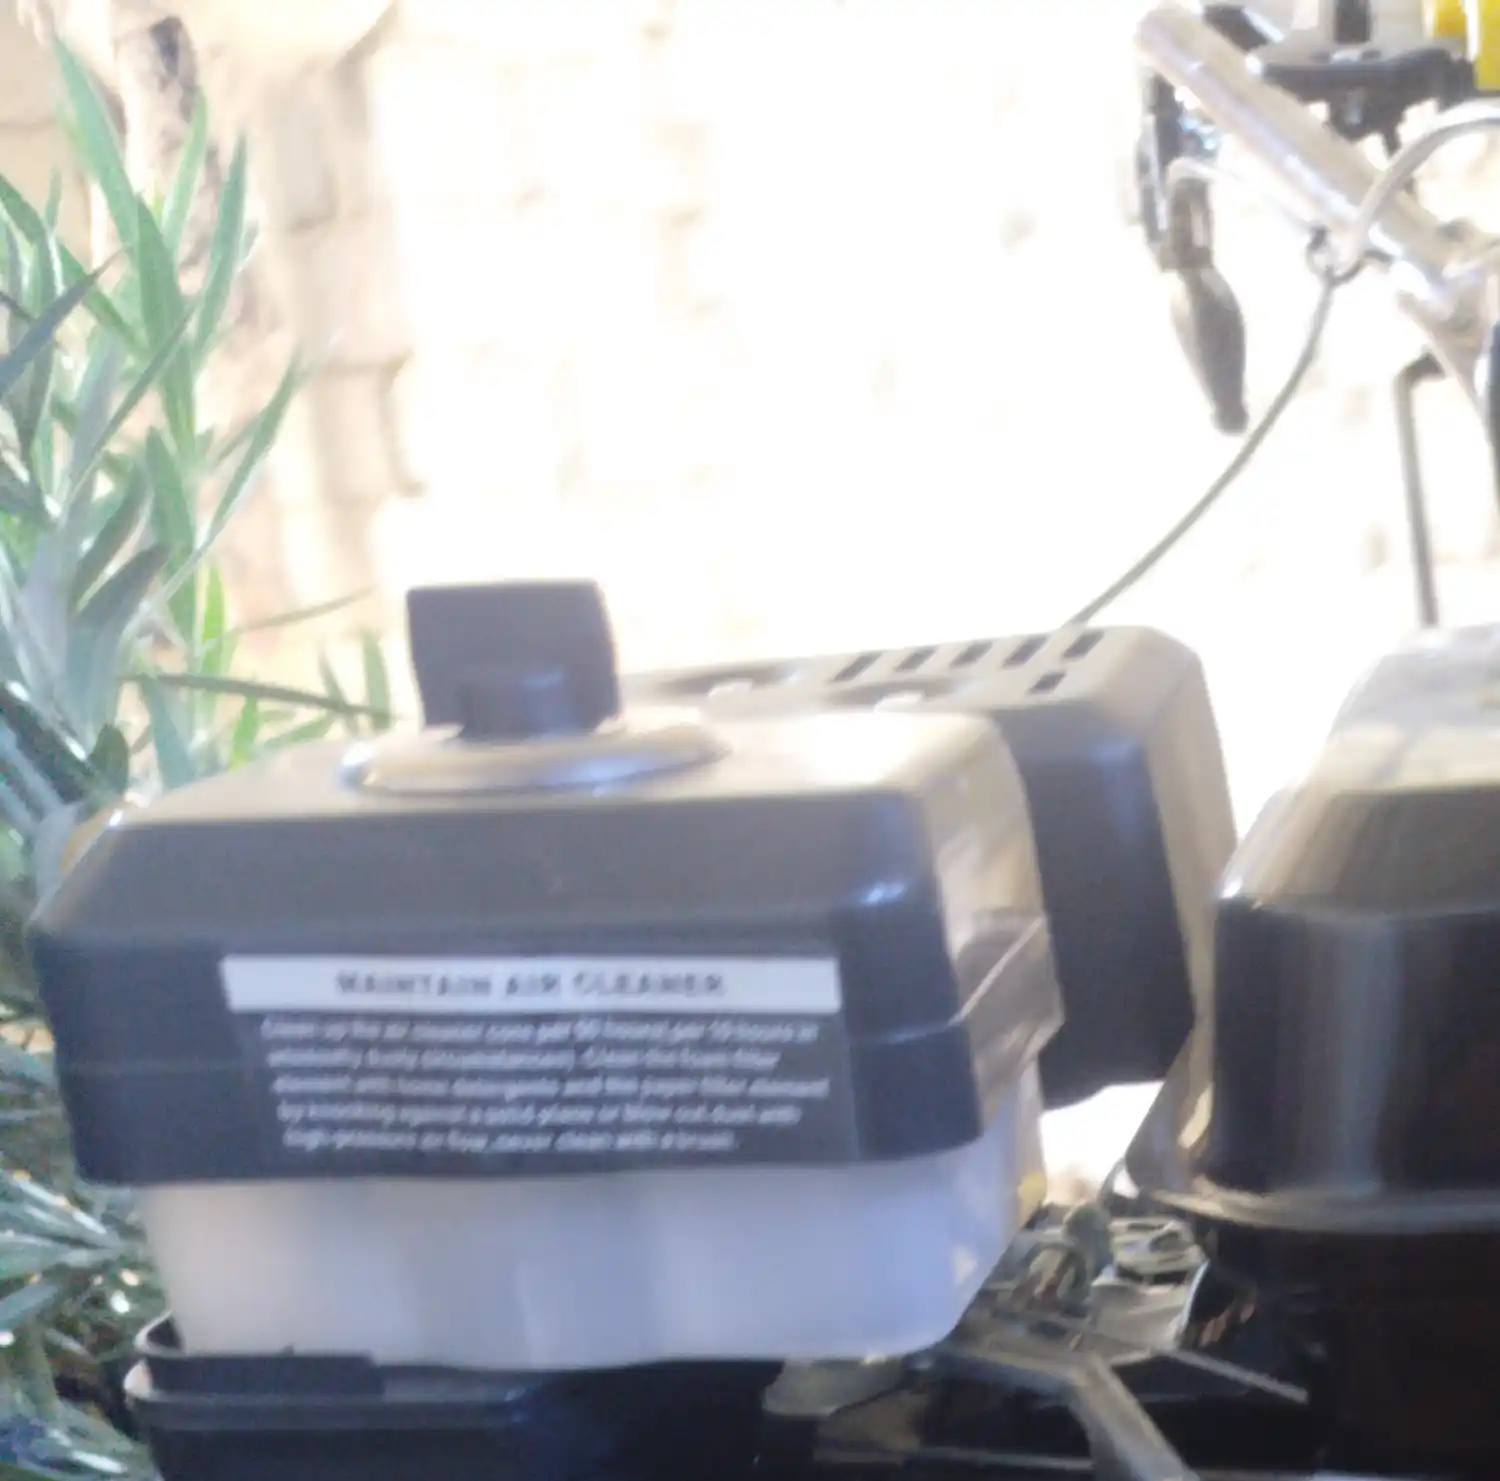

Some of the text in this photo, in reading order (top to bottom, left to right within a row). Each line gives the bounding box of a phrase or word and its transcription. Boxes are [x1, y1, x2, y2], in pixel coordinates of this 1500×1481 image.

[334, 970, 728, 997] MAINTAIN AIR CLEANER
